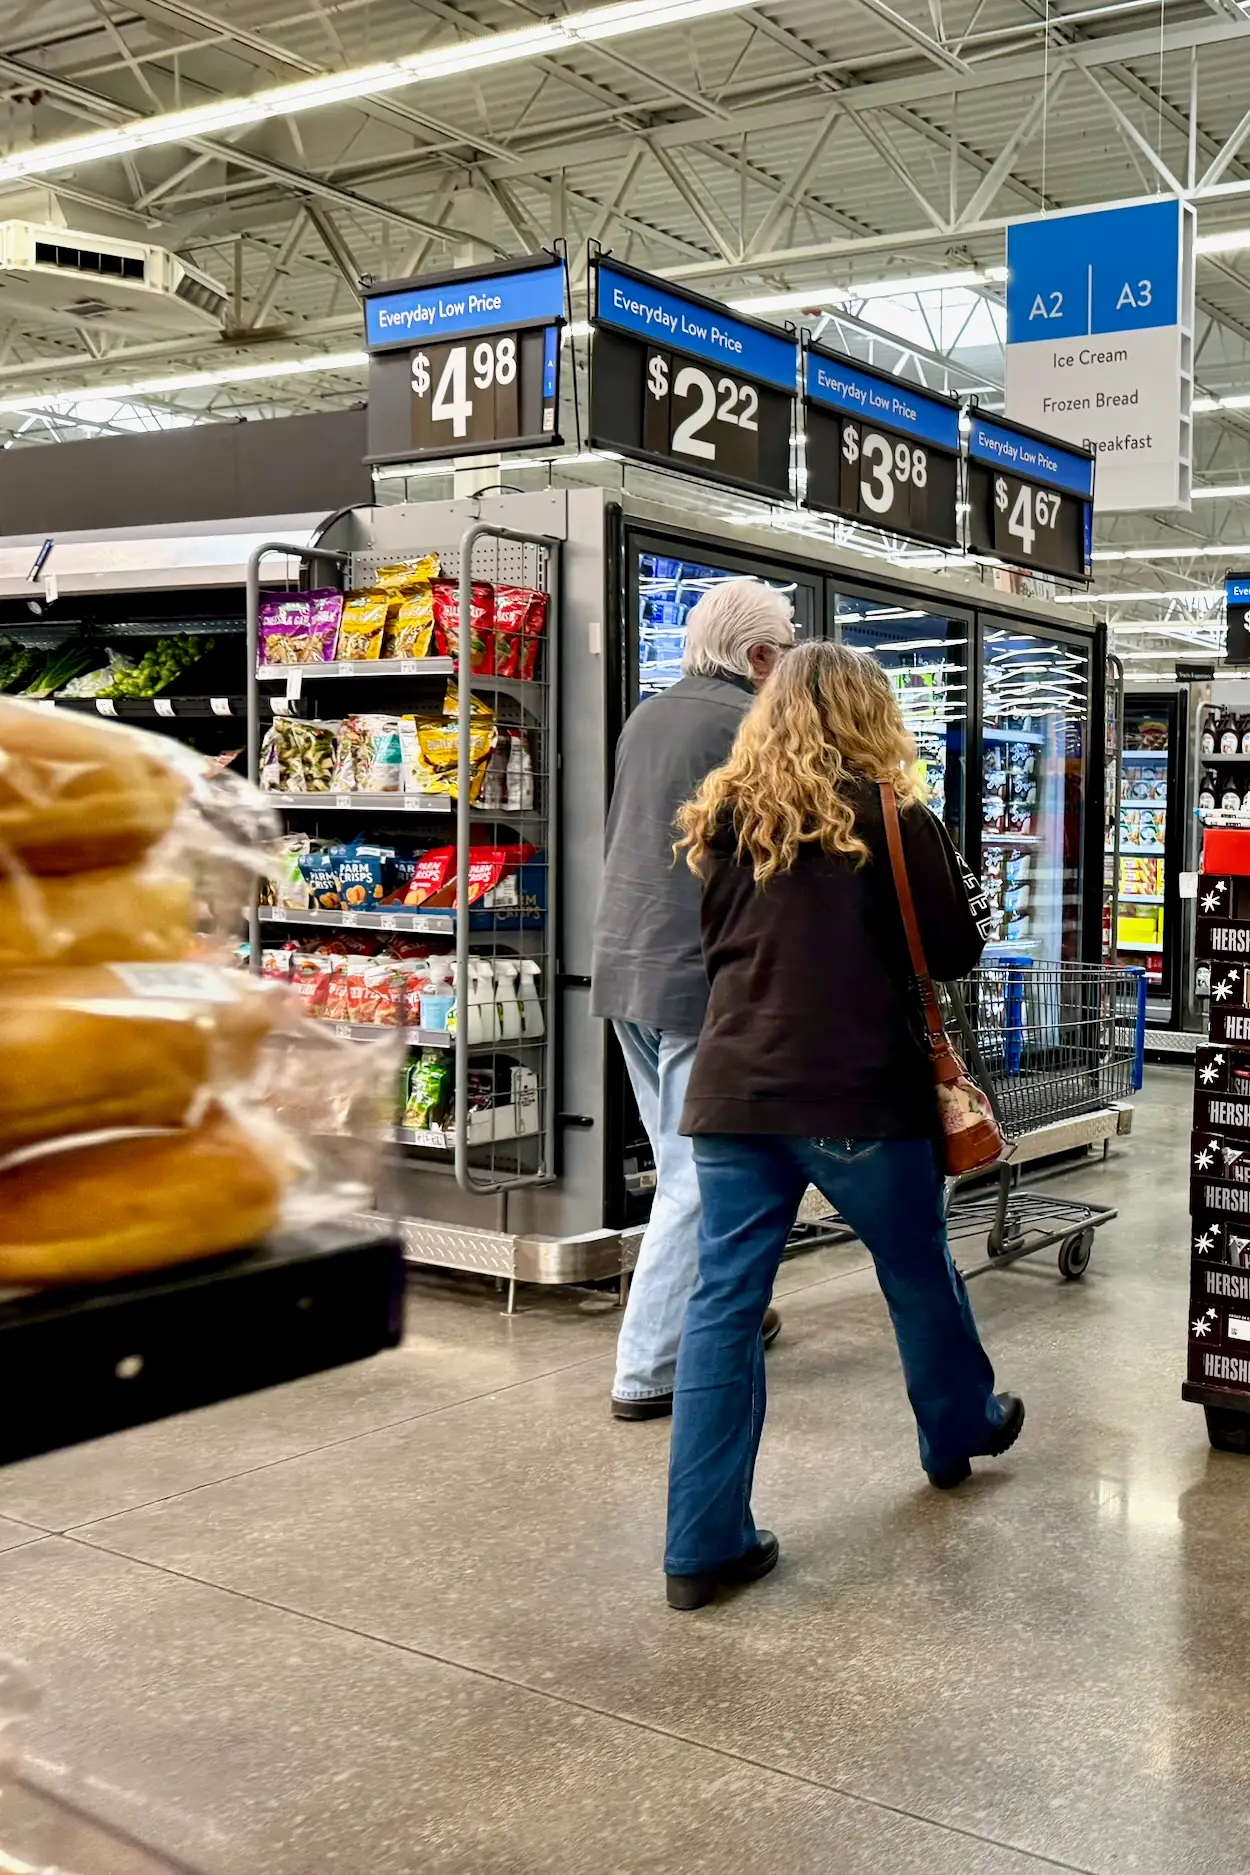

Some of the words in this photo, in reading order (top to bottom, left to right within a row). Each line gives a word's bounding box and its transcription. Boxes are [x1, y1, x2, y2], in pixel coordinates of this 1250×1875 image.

[1028, 291, 1063, 321] A2
[1116, 279, 1152, 310] A3
[378, 304, 436, 328] Everyday
[439, 300, 465, 318] Low
[468, 294, 502, 314] Price
[614, 288, 678, 333] Everyday
[681, 317, 708, 339] Low
[711, 327, 743, 354] Price
[1053, 352, 1074, 369] Ice
[1079, 347, 1128, 367] Cream
[818, 369, 867, 402] Everyday
[869, 392, 890, 410] Low
[892, 398, 917, 421] Price
[1043, 394, 1090, 413] Frozen
[1096, 389, 1139, 408] Bread
[978, 431, 1018, 461] Everyday
[1019, 447, 1037, 463] Low
[1037, 453, 1058, 472] Price
[339, 863, 370, 873] PARM
[339, 872, 374, 884] CRISPS
